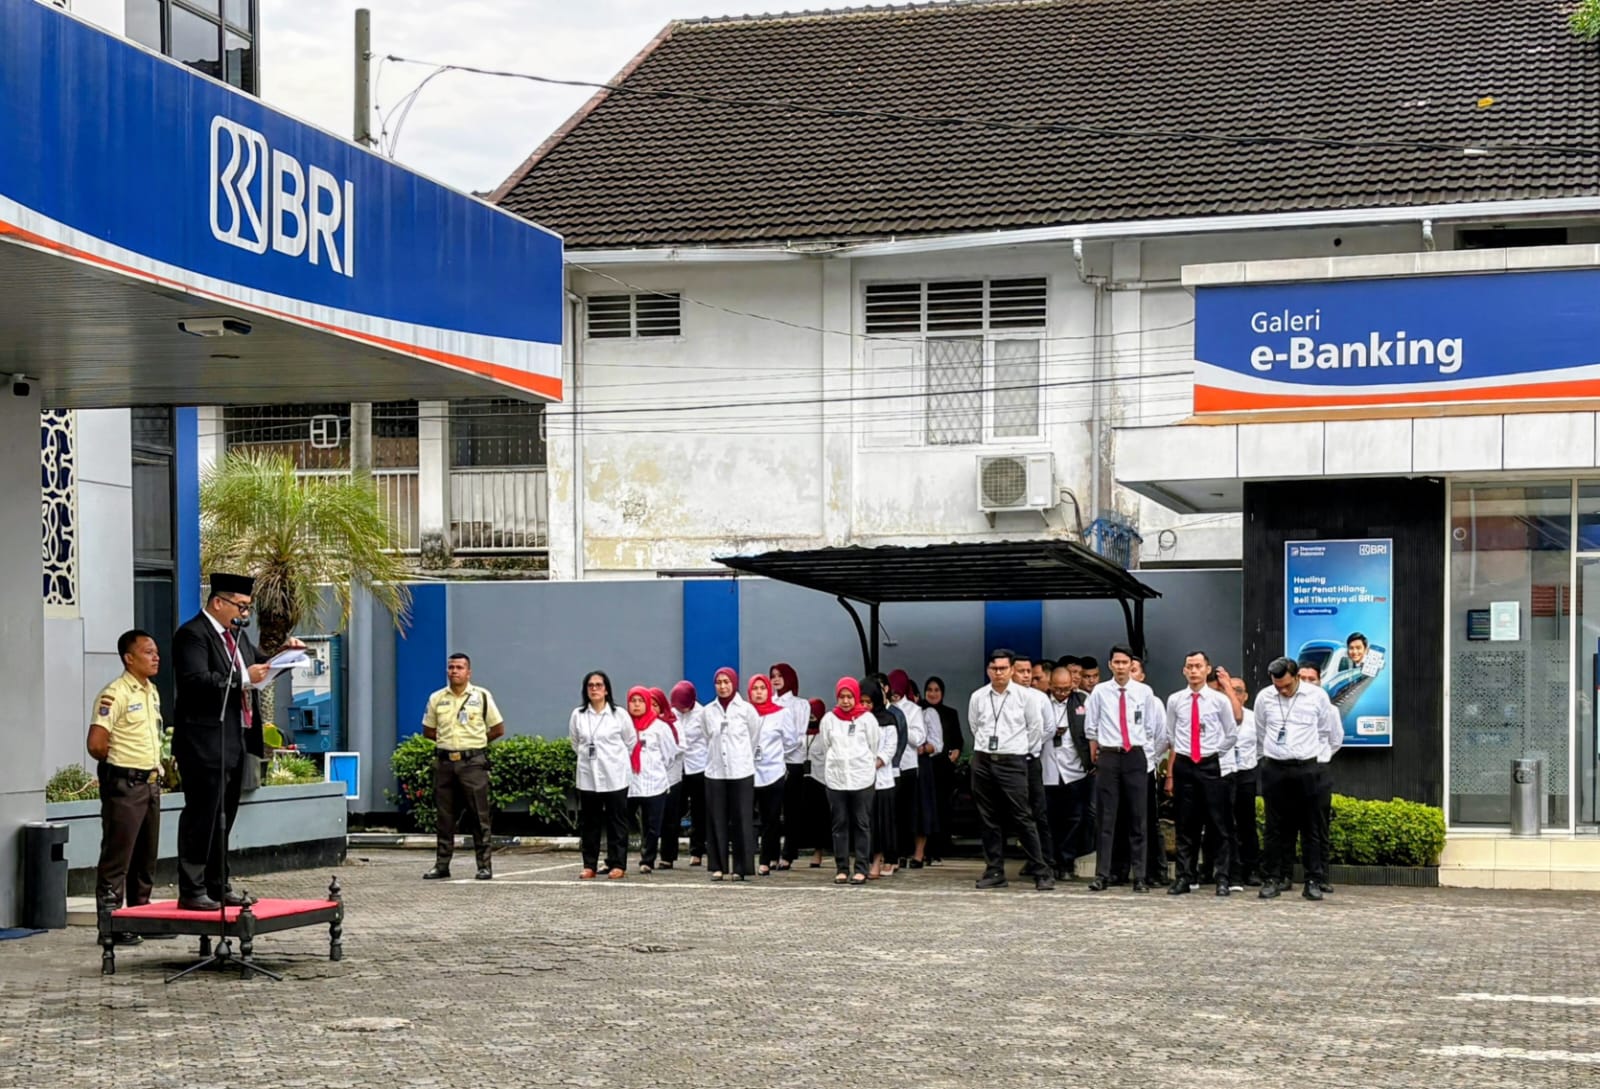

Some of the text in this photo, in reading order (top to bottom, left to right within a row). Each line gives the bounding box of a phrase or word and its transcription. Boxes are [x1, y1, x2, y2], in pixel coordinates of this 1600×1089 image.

[272, 148, 354, 278] BRI
[1251, 309, 1321, 333] Galeri
[1250, 331, 1463, 374] e-Banking
[1371, 544, 1387, 555] BRI
[1293, 576, 1326, 585] Healing
[1293, 586, 1311, 594] Biar
